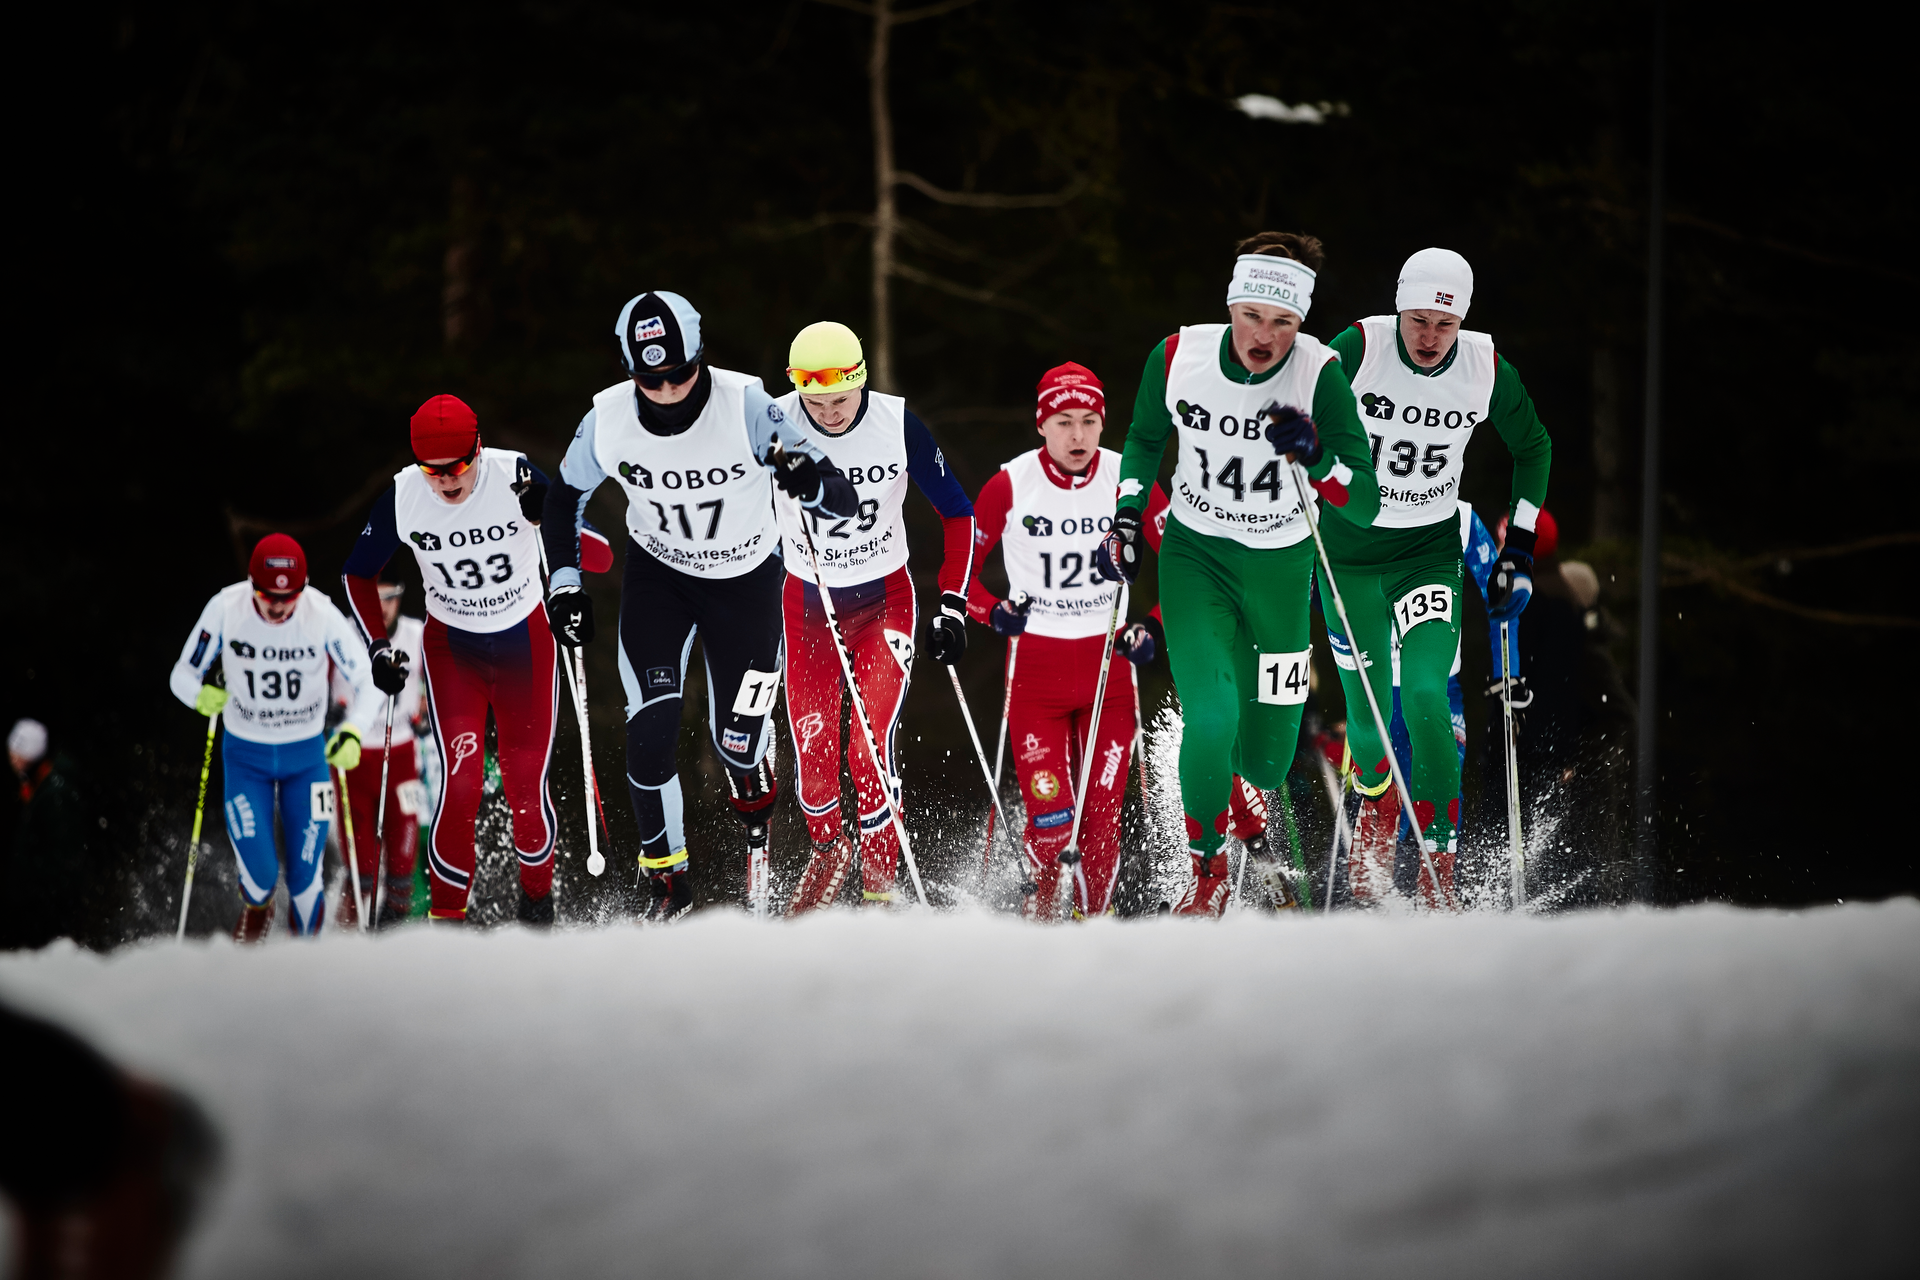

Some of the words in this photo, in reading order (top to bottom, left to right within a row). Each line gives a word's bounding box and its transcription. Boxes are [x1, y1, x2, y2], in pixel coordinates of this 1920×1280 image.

[1243, 282, 1291, 300] RUSTAD
[1292, 292, 1299, 304] IL
[1219, 415, 1276, 441] OB
[1402, 405, 1478, 429] OBOS
[1369, 432, 1453, 479] 135
[661, 462, 746, 490] OBOS
[1193, 445, 1283, 502] 144
[1179, 481, 1210, 513] Oslo
[648, 498, 725, 541] 117
[1060, 516, 1114, 536] OBO
[449, 521, 519, 547] OBOS
[431, 553, 514, 590] 133
[693, 561, 706, 572] og
[1055, 590, 1115, 610] Skifestiv
[1401, 590, 1448, 626] 135
[262, 646, 317, 661] OBOS
[243, 667, 303, 701] 136
[748, 681, 778, 709] 11
